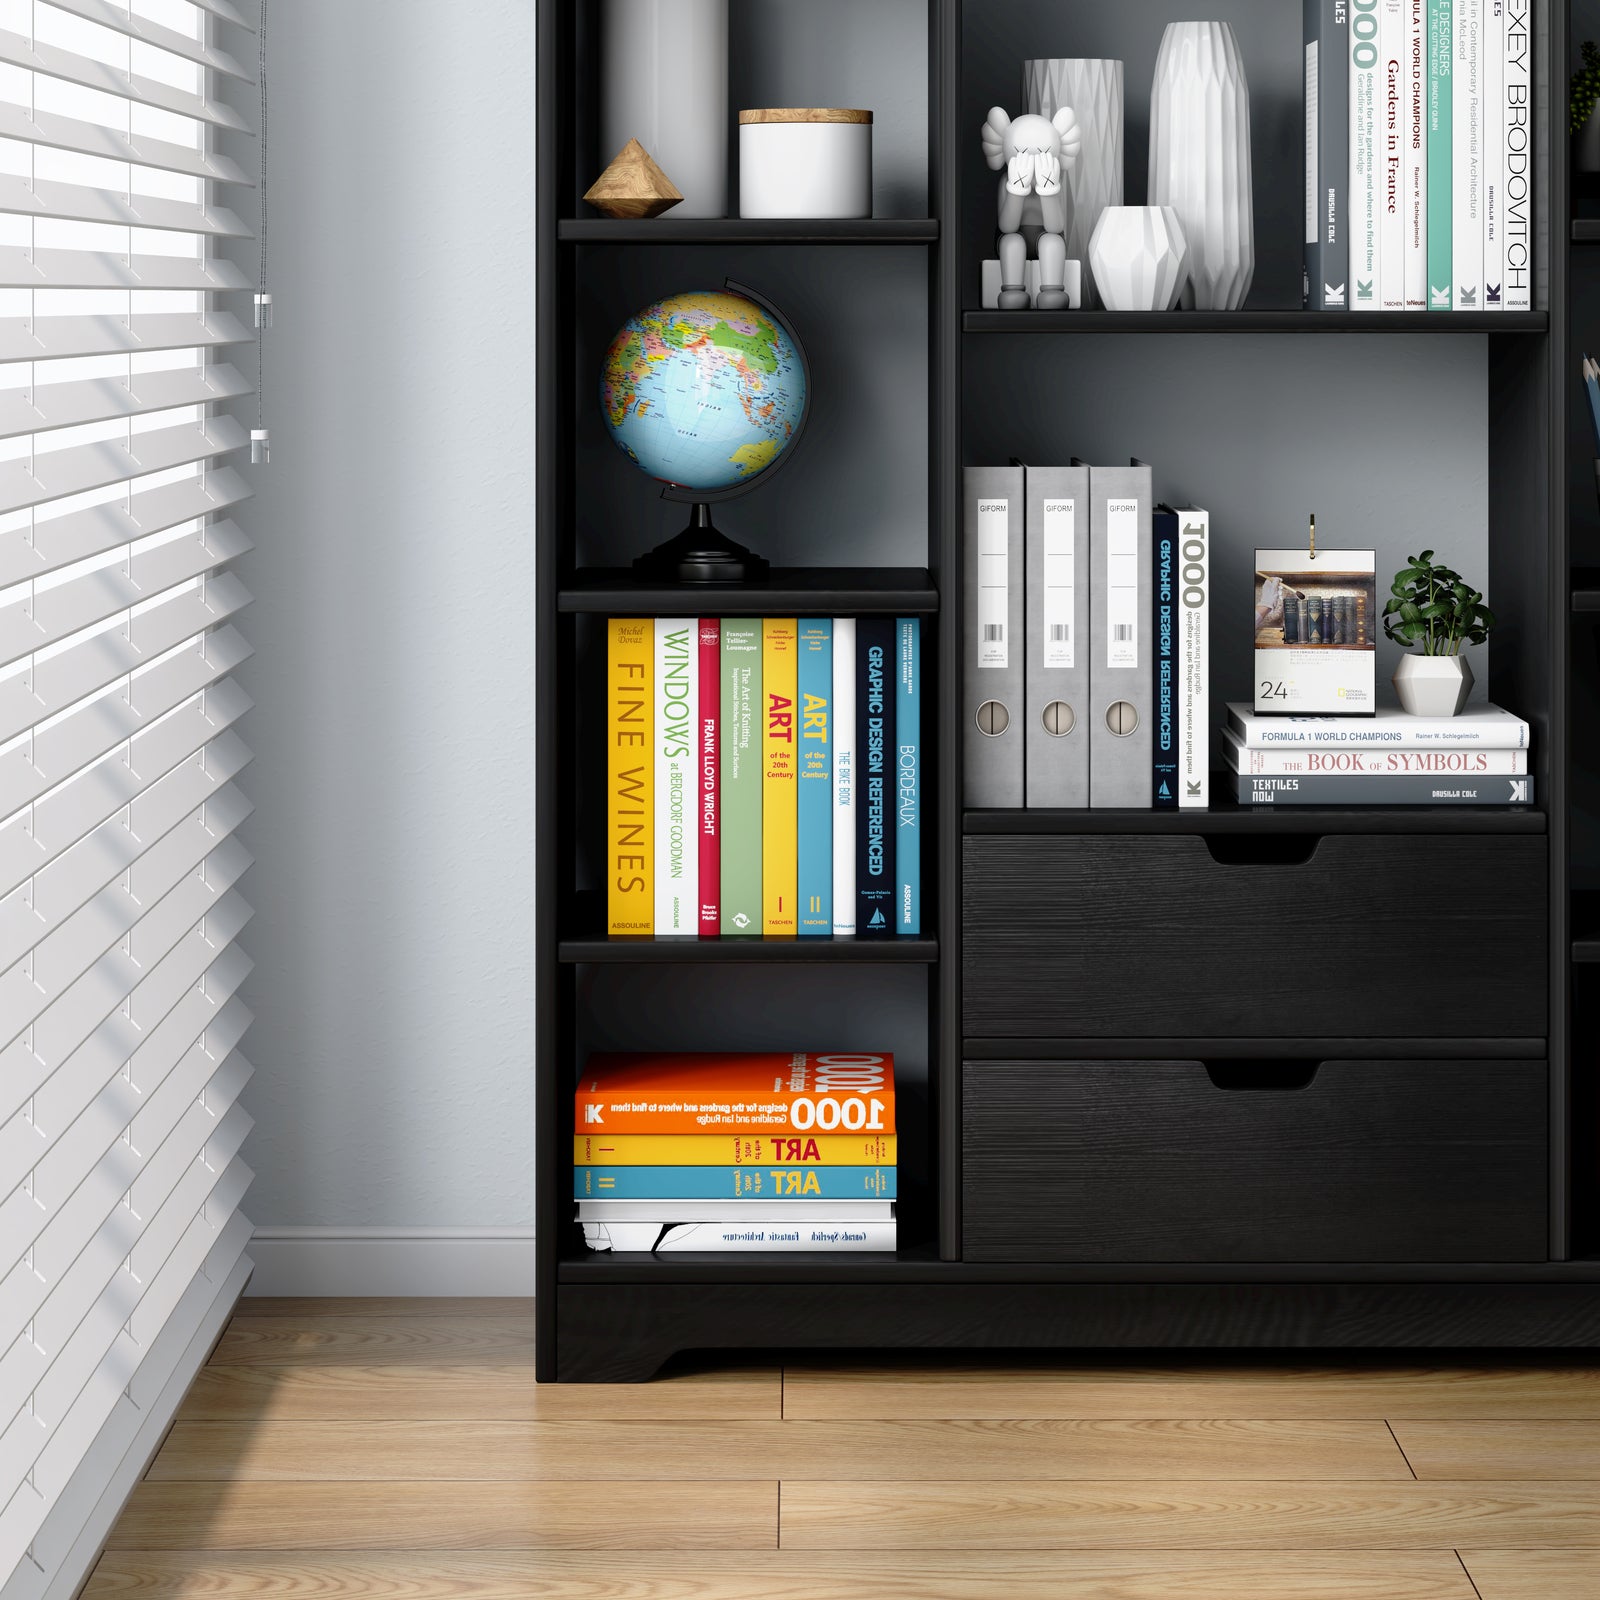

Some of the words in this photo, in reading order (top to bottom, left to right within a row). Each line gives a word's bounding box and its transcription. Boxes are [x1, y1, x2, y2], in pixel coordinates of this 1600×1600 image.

[1440, 13, 1449, 76] DESIGNERS
[1459, 19, 1467, 60] McLeod
[1469, 22, 1478, 94] Contemporary
[1364, 73, 1373, 105] designs
[1388, 60, 1399, 129] Gardens
[1389, 136, 1398, 150] in
[1470, 98, 1478, 154] Residential
[1356, 148, 1365, 174] Rudge
[1364, 138, 1373, 172] gardens
[1388, 157, 1398, 213] France
[1414, 191, 1420, 199] W.
[1470, 157, 1478, 218] Architecture
[1508, 85, 1527, 288] BRODOVITCH
[1367, 220, 1373, 229] to
[697, 402, 721, 412] INDIAN
[618, 627, 644, 636] Michel
[618, 636, 642, 644] Dovaz
[664, 628, 689, 757] WINDOWS
[742, 667, 751, 684] The
[869, 646, 883, 713] GRAPHIC
[1261, 681, 1287, 699] 24
[617, 664, 644, 746] FINE
[742, 686, 750, 700] Art
[742, 702, 751, 711] of
[740, 713, 751, 748] Knitting
[769, 694, 792, 743] ART
[804, 693, 827, 744] ART
[704, 719, 714, 753] FRANK
[869, 718, 883, 772] DESIGN
[1442, 733, 1480, 741] Schlegelmilch
[704, 756, 714, 790] LLOYD
[802, 771, 829, 779] Century
[839, 751, 850, 765] THE
[1308, 754, 1364, 770] BOOK
[1388, 754, 1487, 770] SYMBOLS
[839, 769, 850, 784] BIKE
[900, 746, 915, 826] BORDEAUX
[1253, 780, 1298, 790] TEXTILES
[671, 773, 682, 823] BERGDORF
[839, 788, 850, 805] BOOK
[1253, 791, 1273, 801] NOW
[617, 766, 645, 892] WINES
[704, 792, 714, 835] WRIGHT
[869, 778, 883, 875] REFERENCED
[671, 826, 682, 878] GOODMAN
